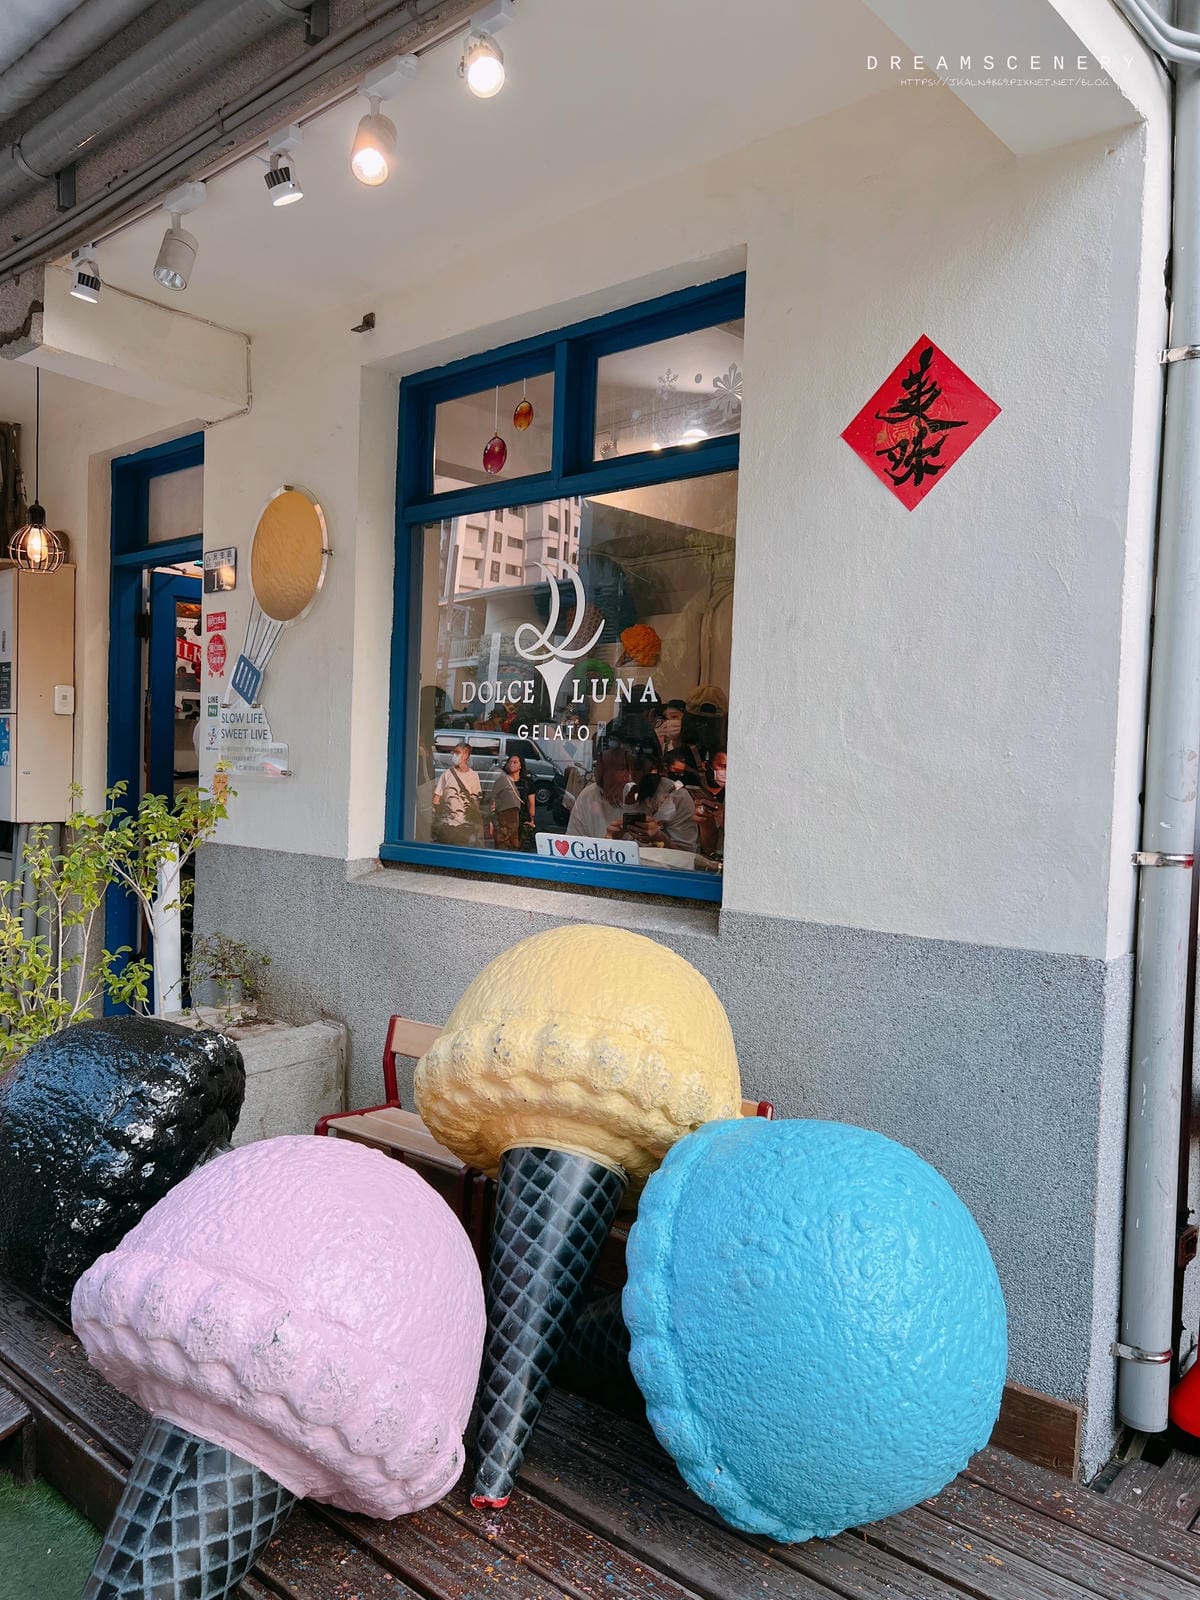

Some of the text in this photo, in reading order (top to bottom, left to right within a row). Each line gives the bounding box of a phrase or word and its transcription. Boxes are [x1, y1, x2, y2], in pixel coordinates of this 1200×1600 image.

[461, 676, 658, 704] DOLCE LUNA
[221, 713, 245, 724] SLOW
[220, 728, 249, 739] SWEET
[517, 724, 590, 741] GELATO
[546, 838, 626, 864] I Gelato
